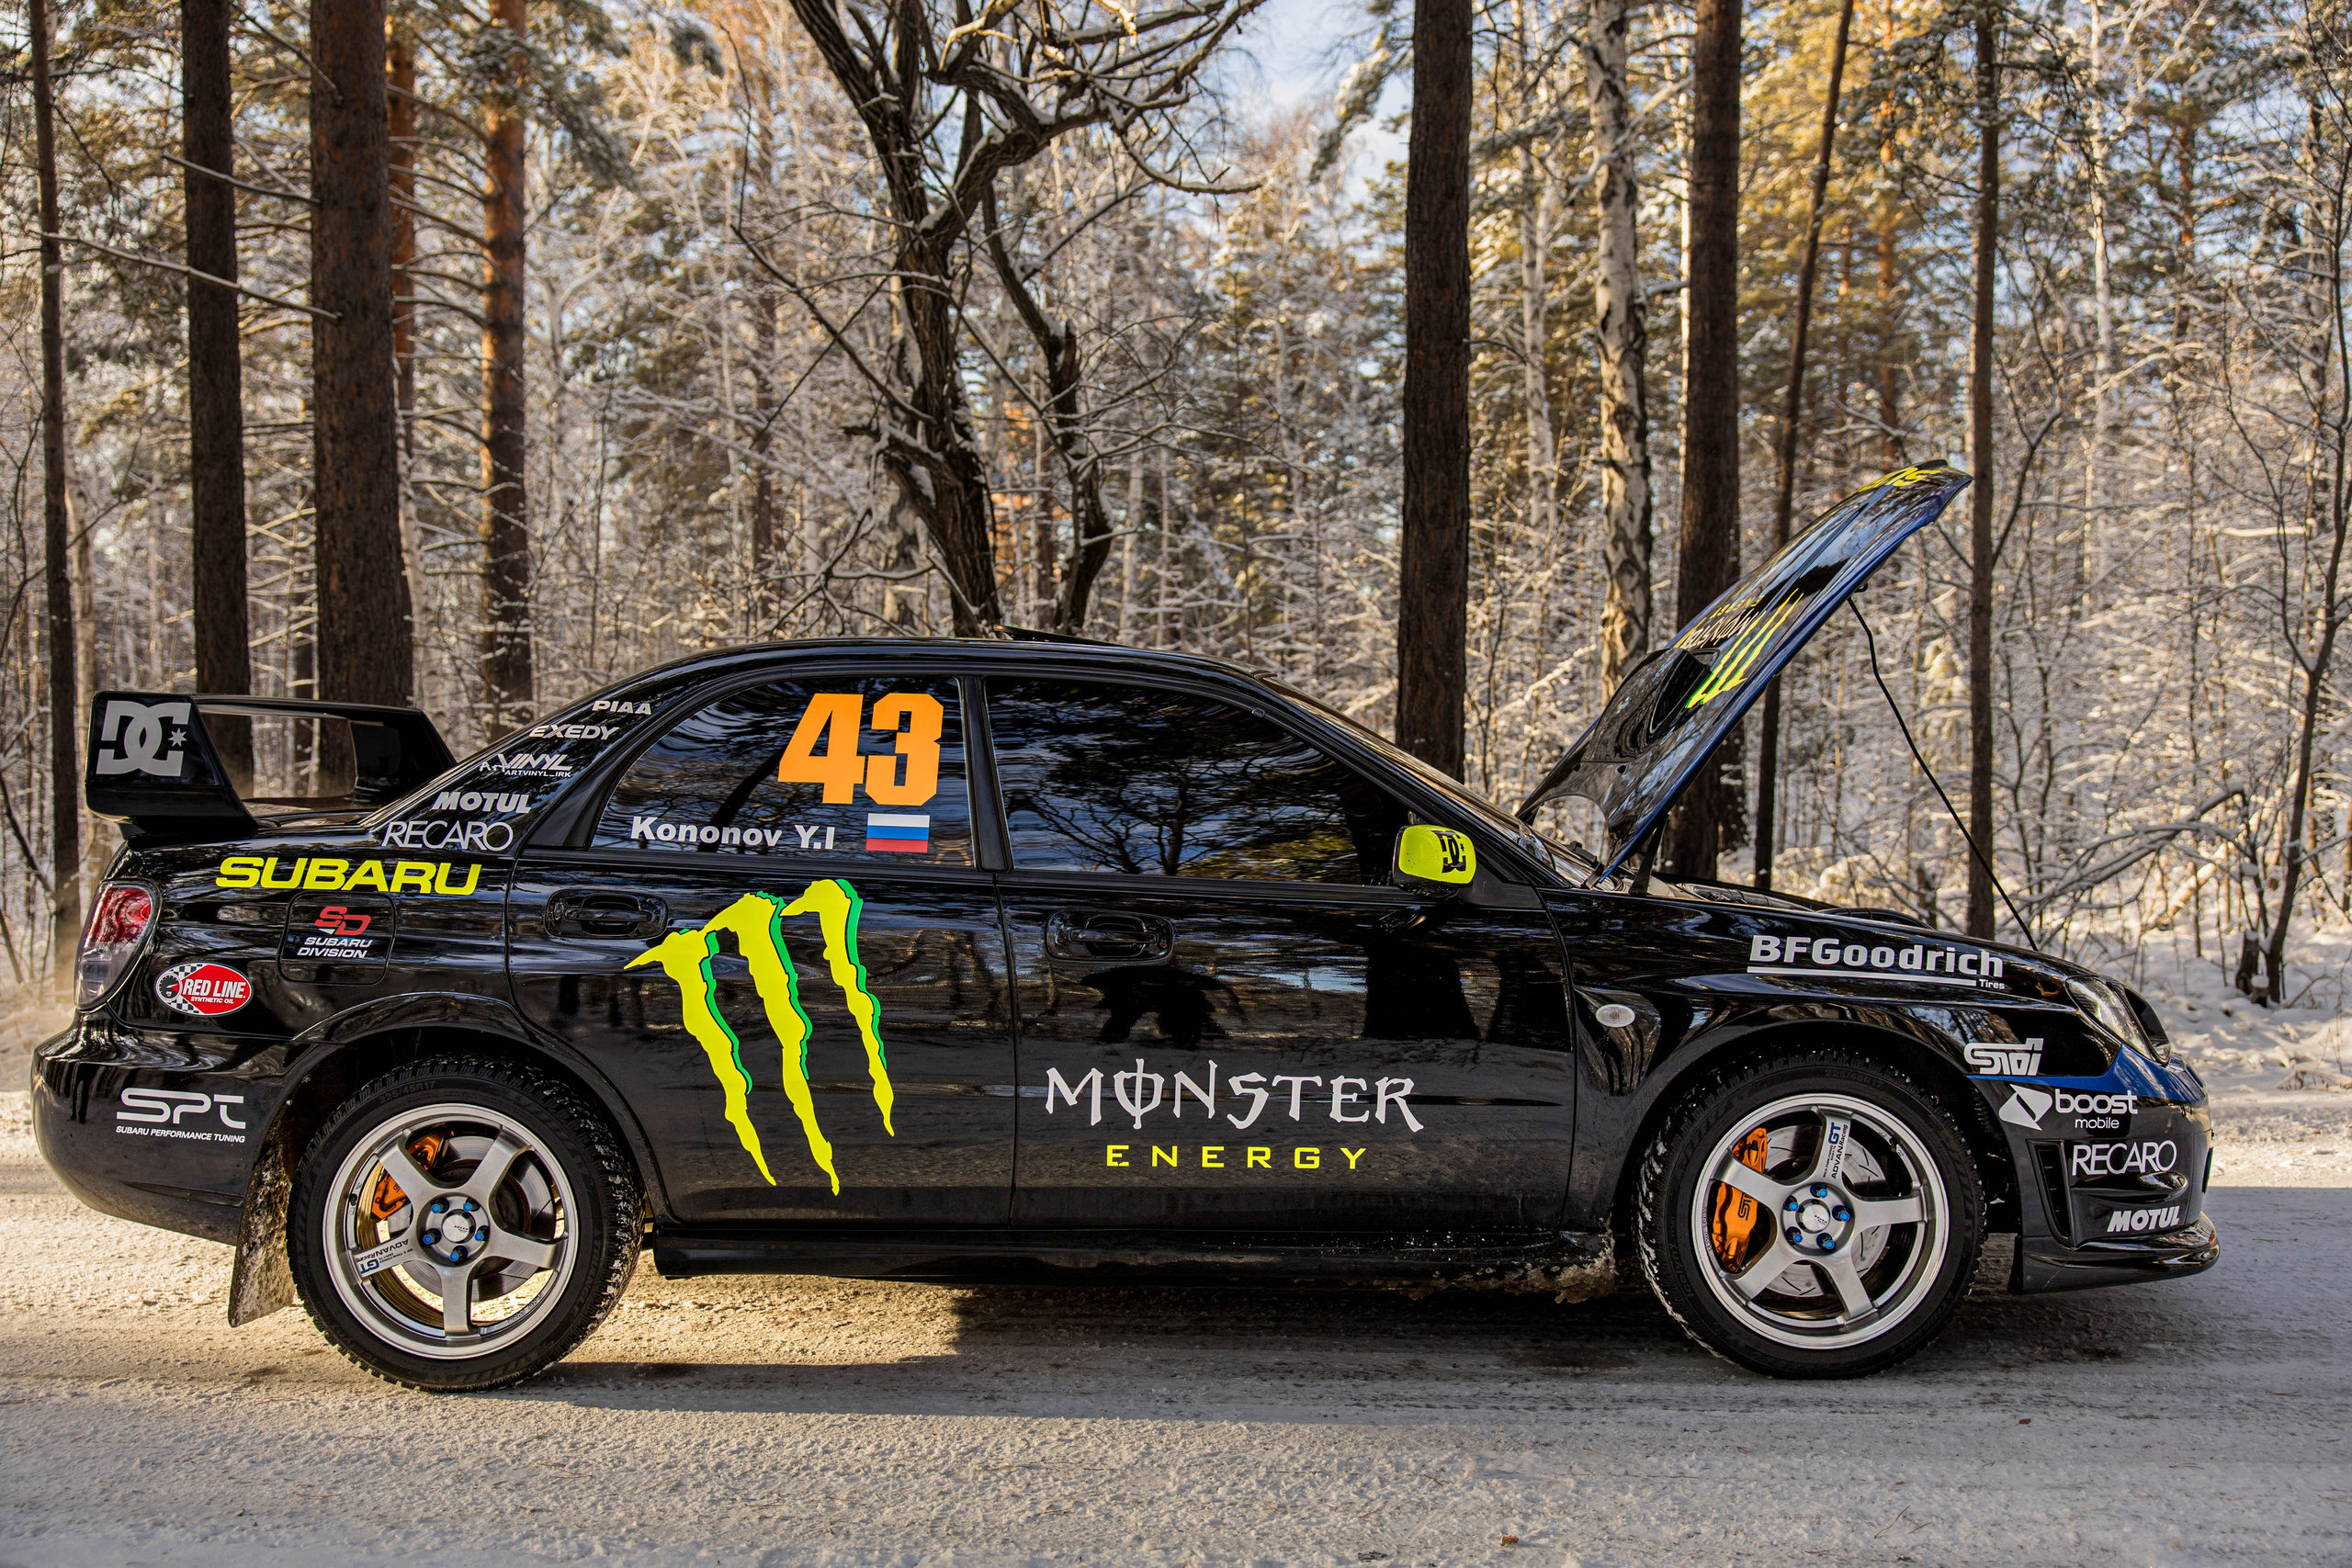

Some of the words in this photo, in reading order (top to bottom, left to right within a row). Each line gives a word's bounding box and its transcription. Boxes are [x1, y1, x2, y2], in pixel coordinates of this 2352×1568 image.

[592, 699, 652, 716] PIAA
[96, 700, 191, 777] DC
[529, 724, 619, 740] EXEDY
[777, 693, 944, 807] 43
[431, 791, 532, 814] MOTUL
[381, 819, 514, 852] RECARO
[630, 816, 782, 847] Kononov
[794, 825, 835, 850] Y.I
[1430, 829, 1466, 874] DC
[216, 856, 482, 896] SUBARU
[297, 947, 368, 958] DIVISION
[304, 936, 373, 948] SUBARU
[1749, 934, 2005, 977] BFGoodrich
[182, 978, 212, 997] RED
[1979, 978, 2006, 990] Tires
[1046, 1058, 1424, 1133] MONSTER
[2054, 1089, 2138, 1114] boost
[116, 1088, 247, 1130] SPT
[116, 1126, 150, 1135] SUBARU
[150, 1128, 212, 1141] PERFORMANCE
[213, 1134, 246, 1144] TUNING
[1828, 1122, 1841, 1145] GT
[2075, 1117, 2120, 1129] mobile
[1106, 1145, 1366, 1170] ENERGY
[2072, 1140, 2178, 1177] RECARO
[2107, 1205, 2181, 1233] MOTUL
[360, 1258, 380, 1275] GT
